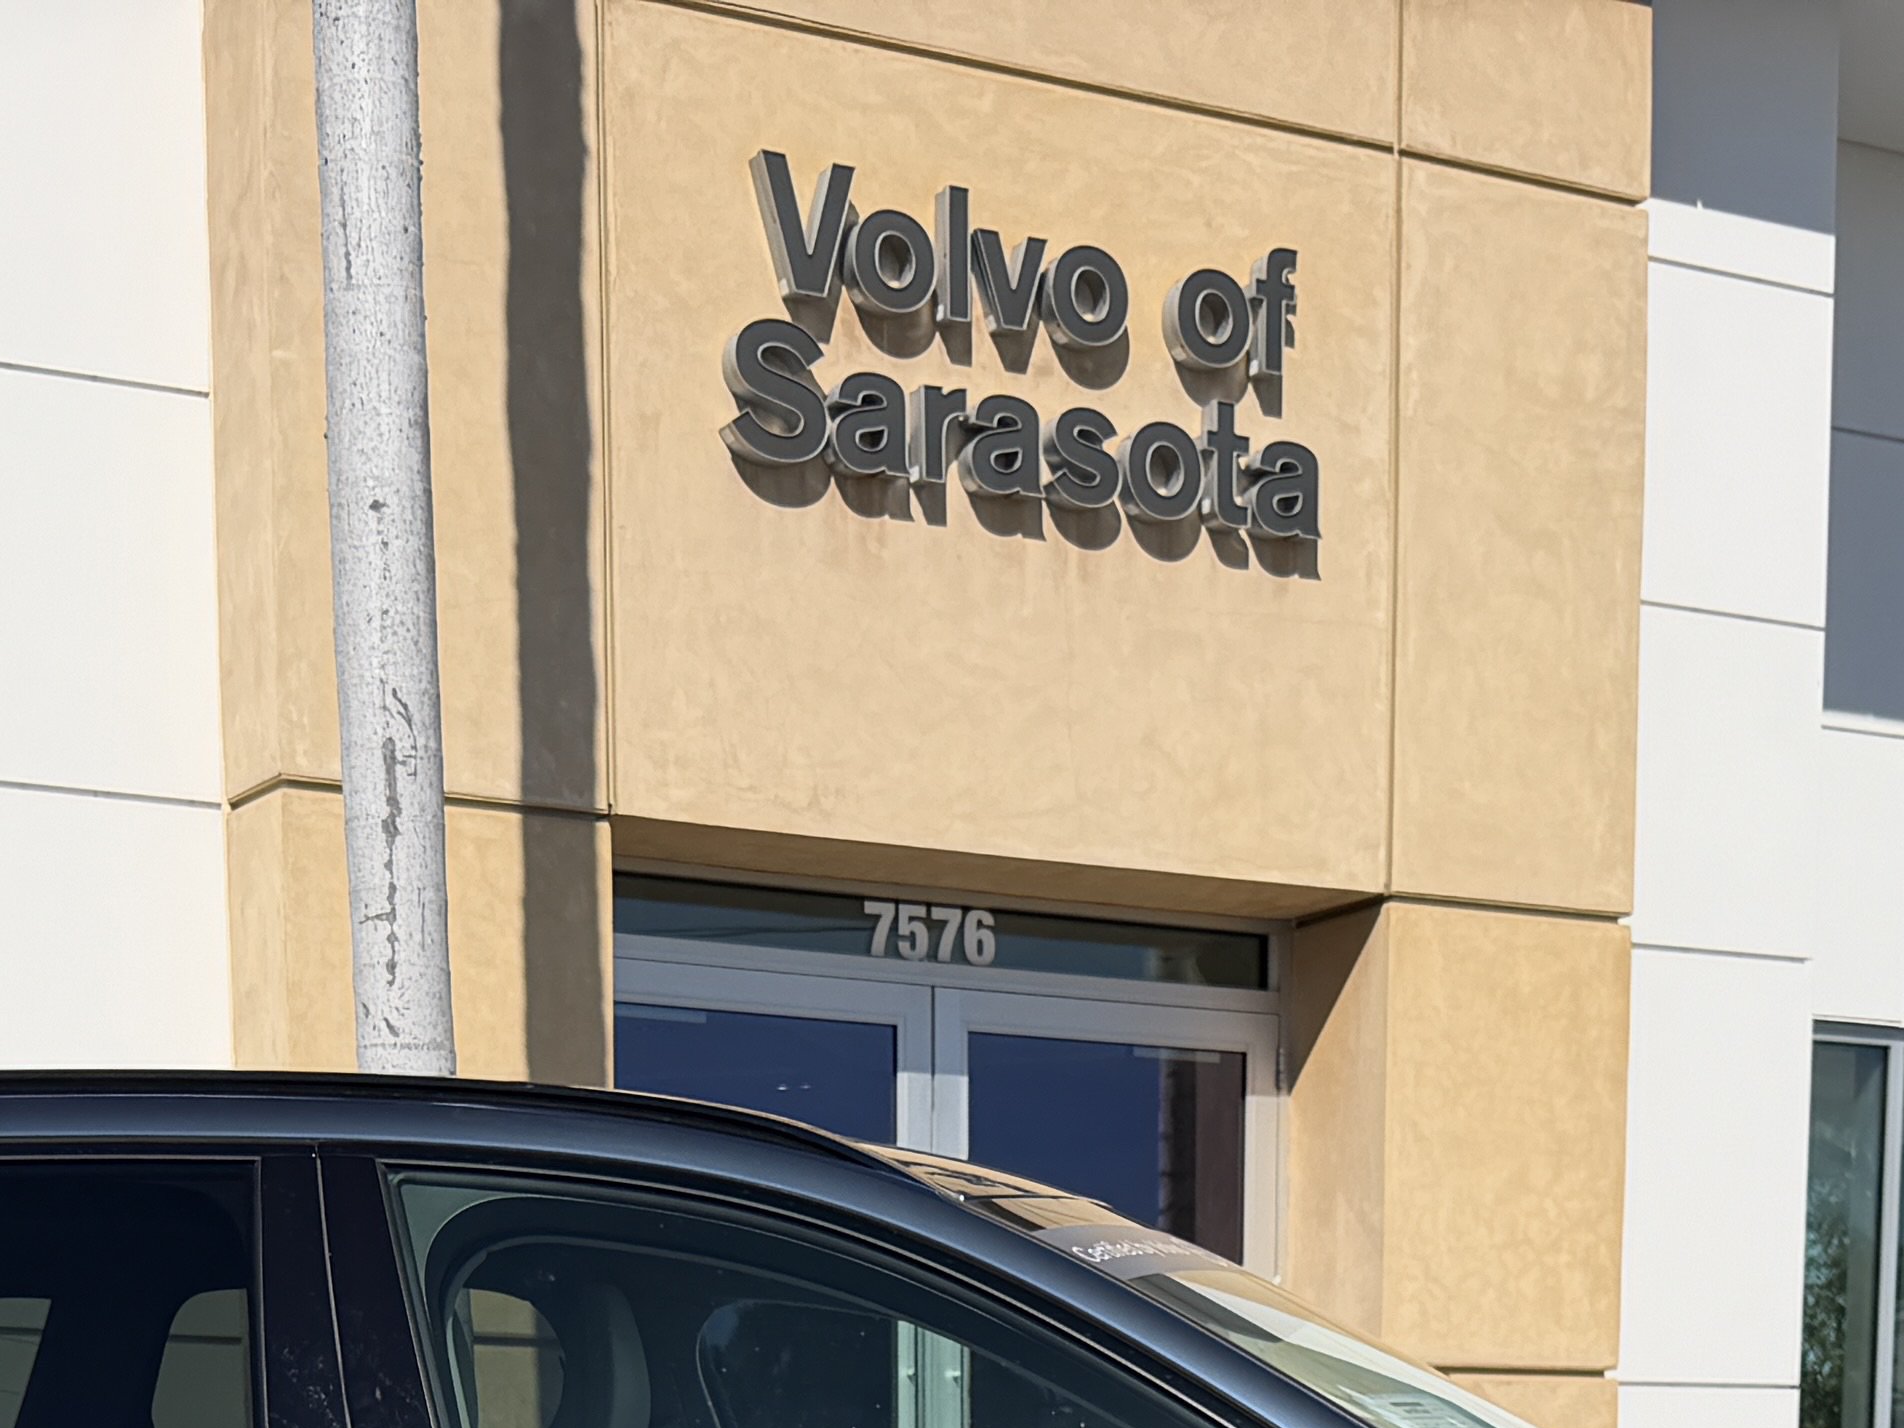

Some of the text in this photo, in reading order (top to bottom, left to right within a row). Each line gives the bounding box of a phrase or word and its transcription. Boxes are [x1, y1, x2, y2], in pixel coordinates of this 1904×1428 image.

[749, 148, 1298, 376] Volvo of
[719, 318, 1322, 540] Sarasota
[863, 900, 996, 966] 7576
